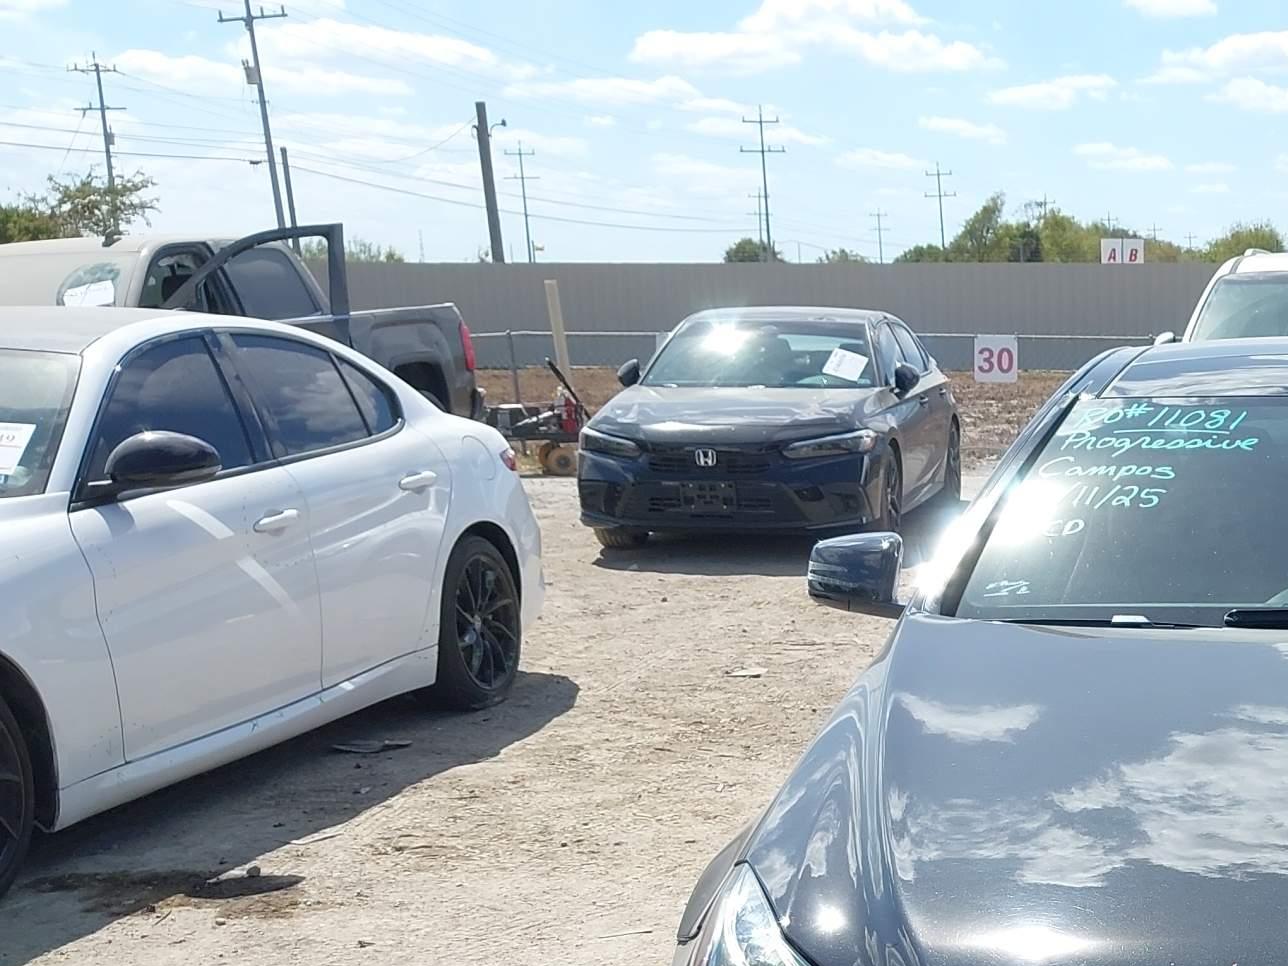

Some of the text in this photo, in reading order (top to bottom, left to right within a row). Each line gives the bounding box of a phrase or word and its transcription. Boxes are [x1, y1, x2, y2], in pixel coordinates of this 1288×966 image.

[1108, 248, 1117, 262] A
[1129, 249, 1138, 262] B
[978, 347, 1013, 374] 30
[1061, 430, 1259, 457] Progressive
[1039, 456, 1176, 481] Campos
